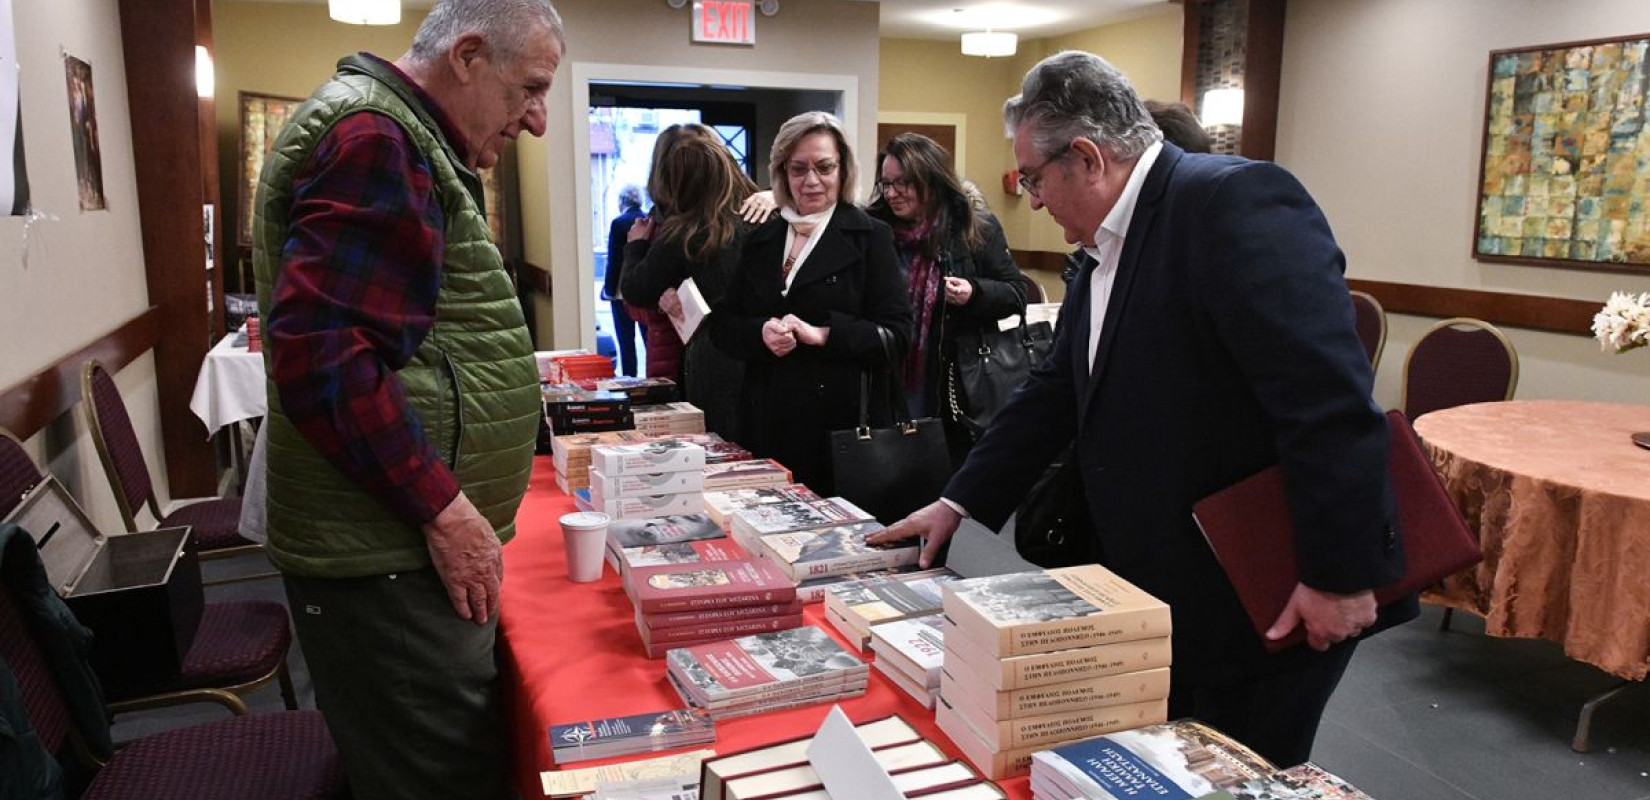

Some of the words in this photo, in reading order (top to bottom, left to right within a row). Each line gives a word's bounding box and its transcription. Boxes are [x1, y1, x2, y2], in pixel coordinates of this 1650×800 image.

[703, 2, 749, 39] EXIT
[809, 563, 829, 575] 1821
[810, 588, 826, 600] 182
[908, 639, 940, 656] 1922
[1086, 758, 1129, 788] ΜΕΓΑΛΗ
[1101, 757, 1145, 790] ΓΑΛΛΙΚΗ
[1102, 748, 1169, 795] ΕΠΑΝΑΣΤΑΣΗ
